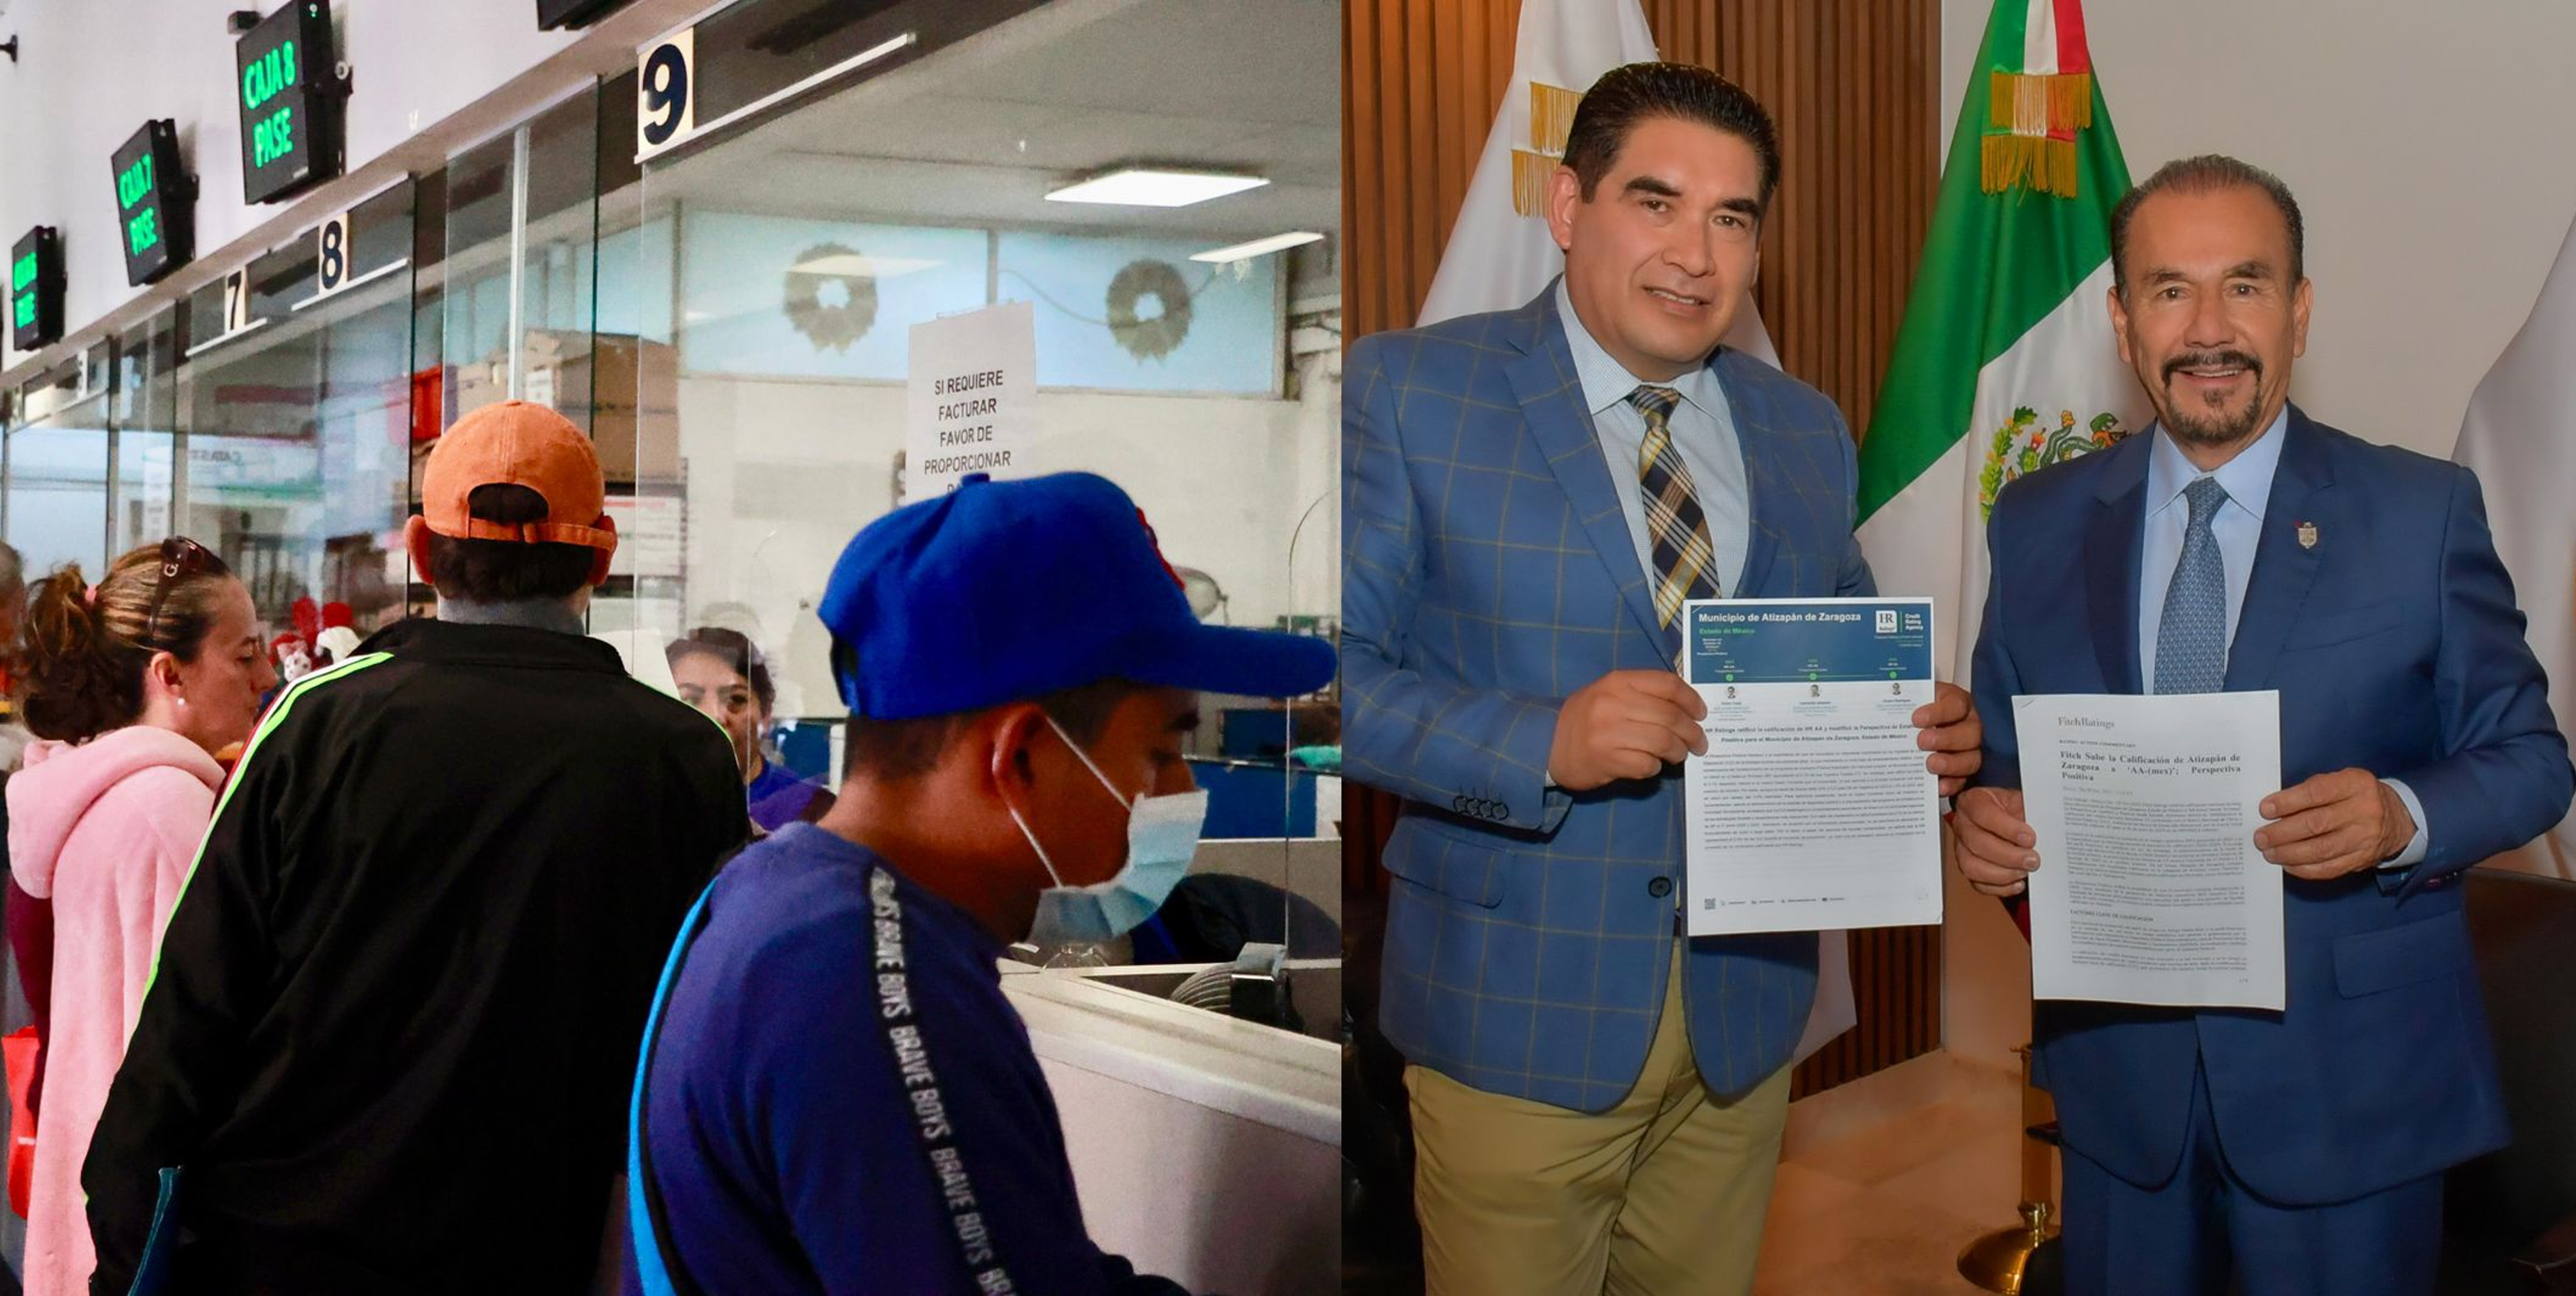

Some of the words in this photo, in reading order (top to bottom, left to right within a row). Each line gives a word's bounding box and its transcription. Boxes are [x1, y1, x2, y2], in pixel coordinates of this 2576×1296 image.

[244, 47, 283, 110] CAJA
[282, 40, 296, 86] 8
[642, 44, 688, 145] 9
[253, 106, 293, 169] PASE
[321, 220, 343, 290] 8
[227, 271, 242, 330] 7
[935, 379, 944, 396] SI
[947, 369, 1004, 394] REQUIERE
[938, 398, 997, 421] FACTURAR
[940, 428, 974, 447] FAVOR
[977, 425, 993, 442] DE
[925, 450, 1011, 476] PROPORCIONAR
[1699, 613, 1745, 624] Municipio
[1748, 613, 1759, 622] de
[1761, 612, 1803, 623] Atizapán
[1805, 613, 1816, 621] de
[1819, 612, 1861, 623] Zaragoza
[1880, 613, 1894, 624] HR
[2058, 717, 2115, 730] FitchRatings
[2060, 751, 2082, 760] Fitch
[2085, 753, 2106, 762] Sube
[2109, 753, 2116, 762] la
[2119, 754, 2171, 764] Calificación
[2174, 755, 2184, 764] de
[2187, 754, 2227, 765] Atizapán
[2229, 753, 2241, 762] de
[2061, 762, 2100, 772] Zaragoza
[2191, 766, 2242, 775] Perspectiva
[2061, 772, 2094, 782] Positiva
[878, 972, 912, 1019] BOYS
[889, 1024, 935, 1087] BRAVE
[911, 1087, 952, 1140] BOYS
[930, 1147, 976, 1211] BRAVE
[954, 1211, 994, 1265] BOYS
